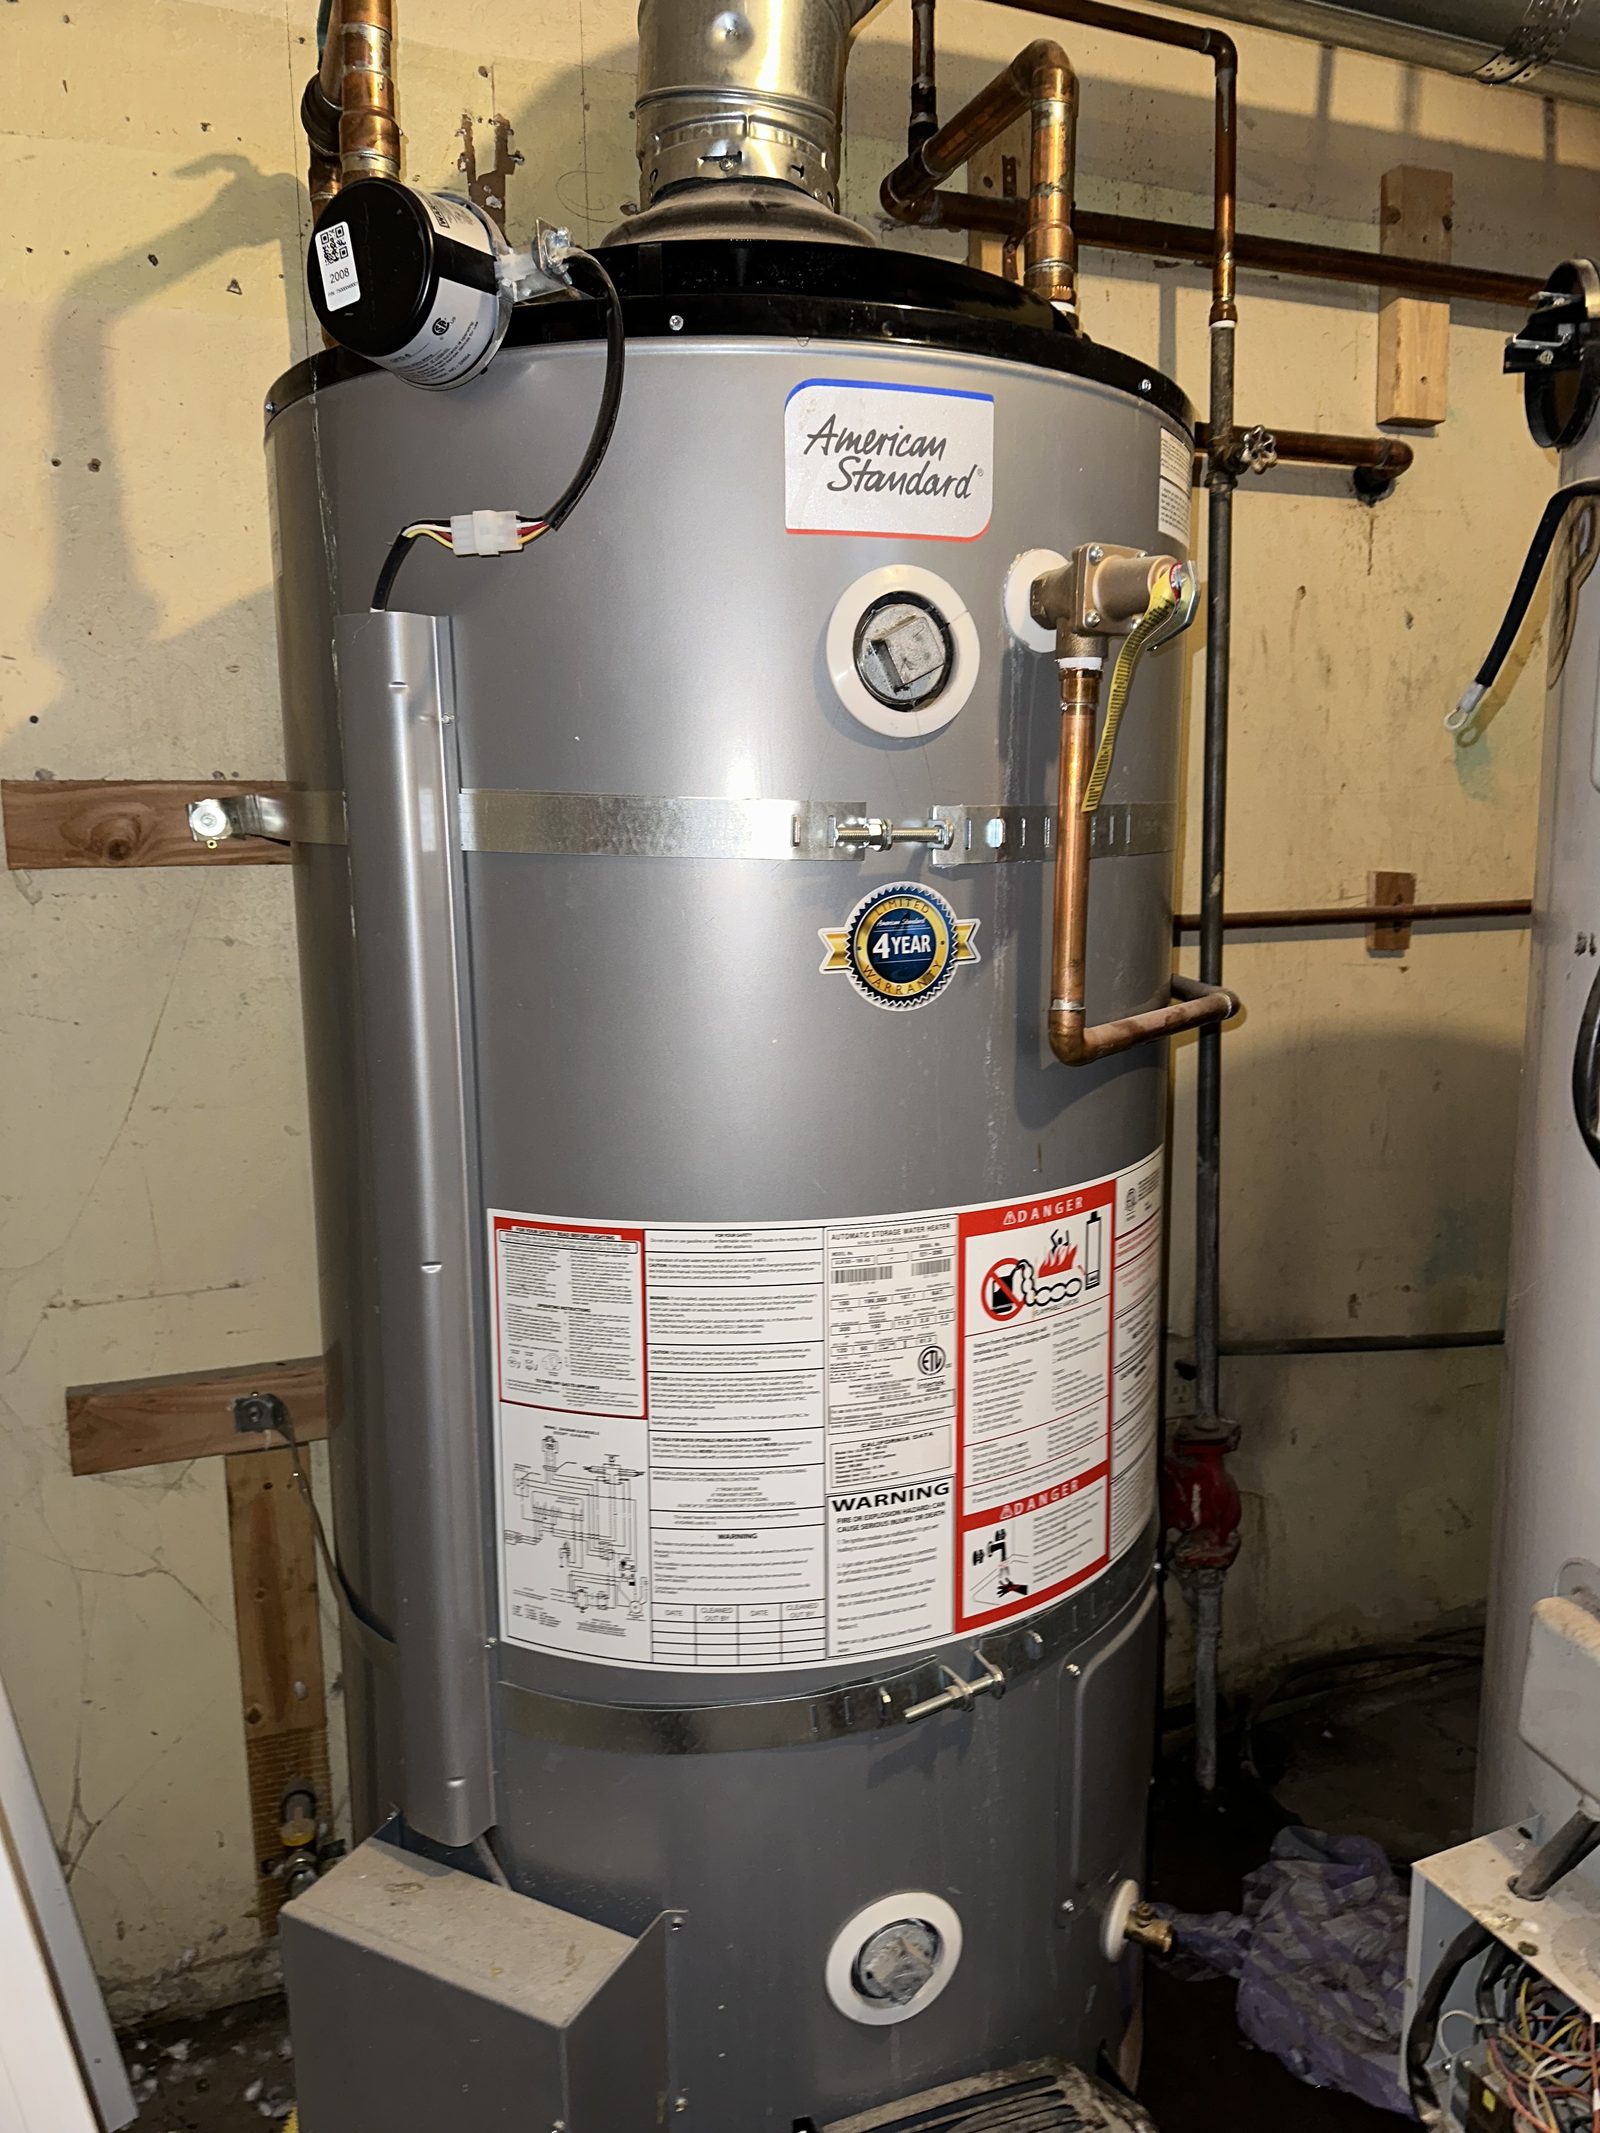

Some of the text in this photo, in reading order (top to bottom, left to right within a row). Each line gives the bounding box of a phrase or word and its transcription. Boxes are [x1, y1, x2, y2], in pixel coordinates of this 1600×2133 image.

[330, 268, 350, 283] 2008
[803, 414, 947, 461] American
[827, 456, 978, 499] Standard
[874, 899, 930, 915] LIMITED
[872, 933, 931, 959] 4 YEAR
[861, 960, 942, 995] WARRANTY
[1016, 1197, 1084, 1223] DANGER
[831, 1231, 870, 1240] AUTOMATIC
[871, 1229, 901, 1238] STORAGE
[903, 1226, 925, 1234] WATER
[927, 1223, 950, 1231] HEATER
[832, 1482, 950, 1512] WARNING
[1013, 1479, 1079, 1516] DANGER
[837, 1516, 851, 1524] FIRE
[837, 1525, 860, 1533] CAUSE
[750, 1609, 769, 1617] DATE
